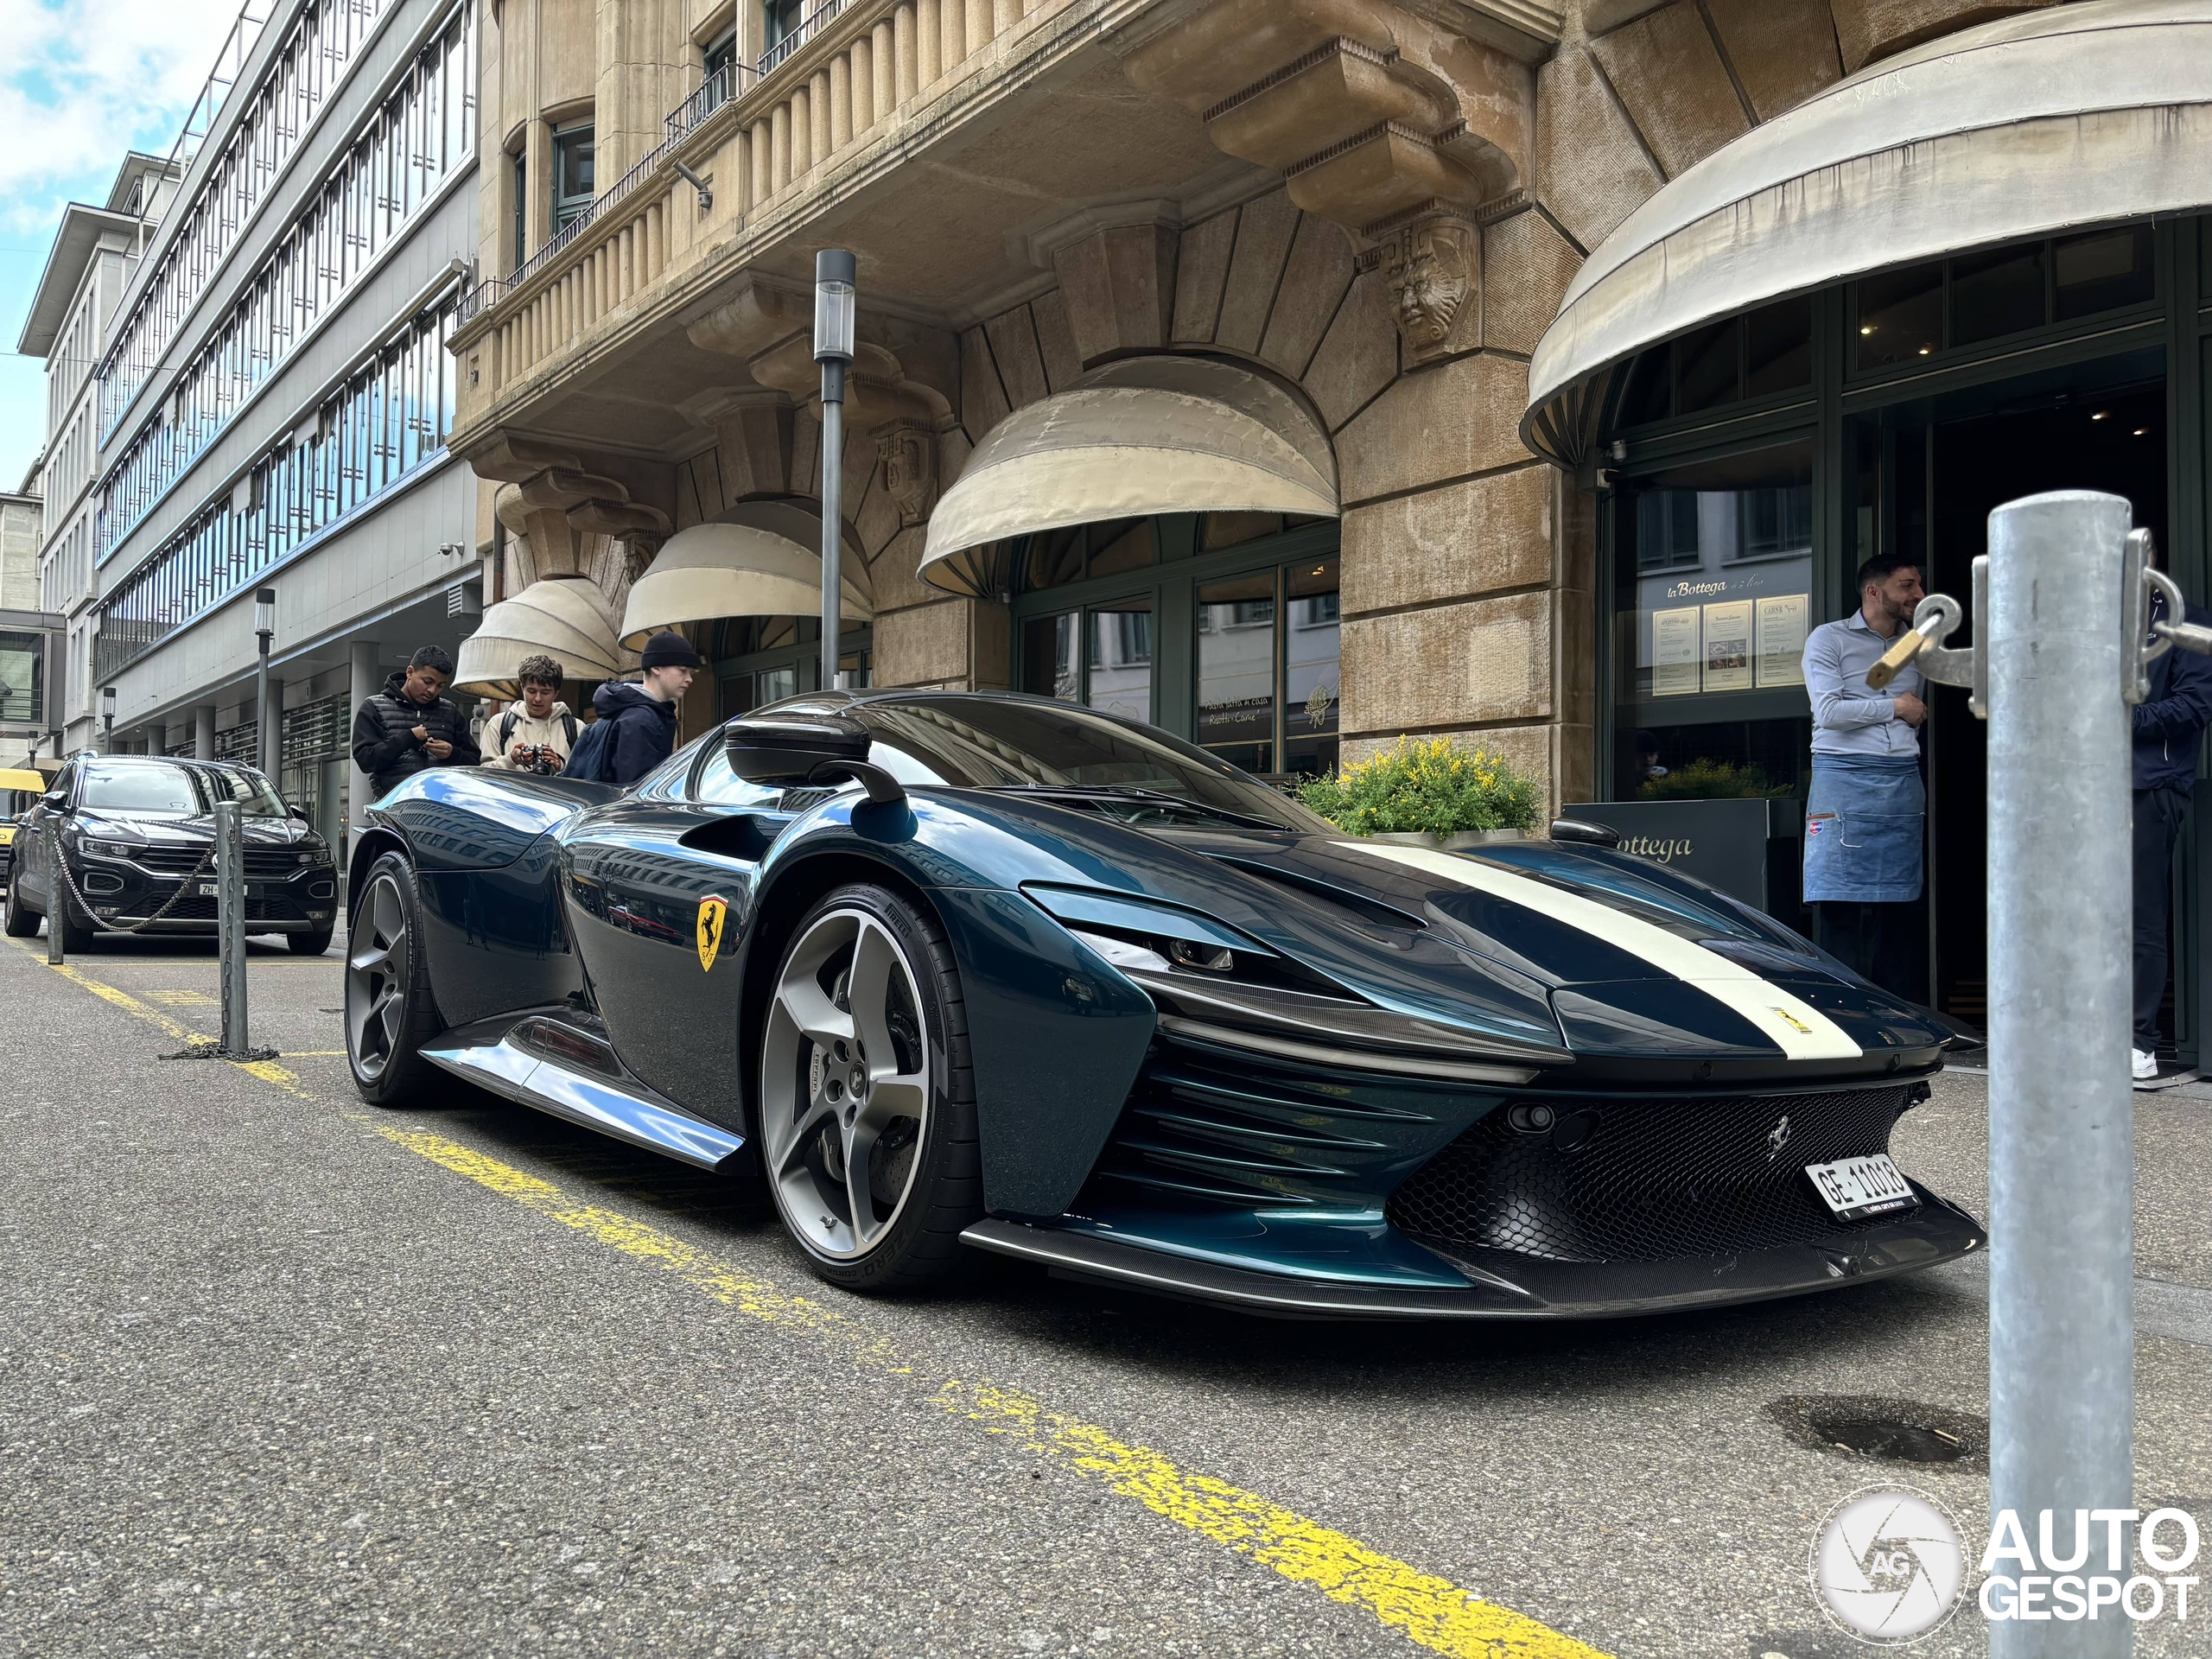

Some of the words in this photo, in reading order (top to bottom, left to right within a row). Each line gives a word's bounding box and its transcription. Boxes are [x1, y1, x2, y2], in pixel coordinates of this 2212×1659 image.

[1667, 588, 1677, 598] la
[1677, 582, 1727, 596] Bottega
[1251, 697, 1268, 706] casa
[1210, 712, 1230, 725] Risotti
[1617, 836, 1694, 864] ottega
[884, 902, 912, 938] PIRELLI
[1817, 1169, 1854, 1205] GE
[1849, 1160, 1905, 1198] 11018
[827, 1267, 857, 1277] CORSA
